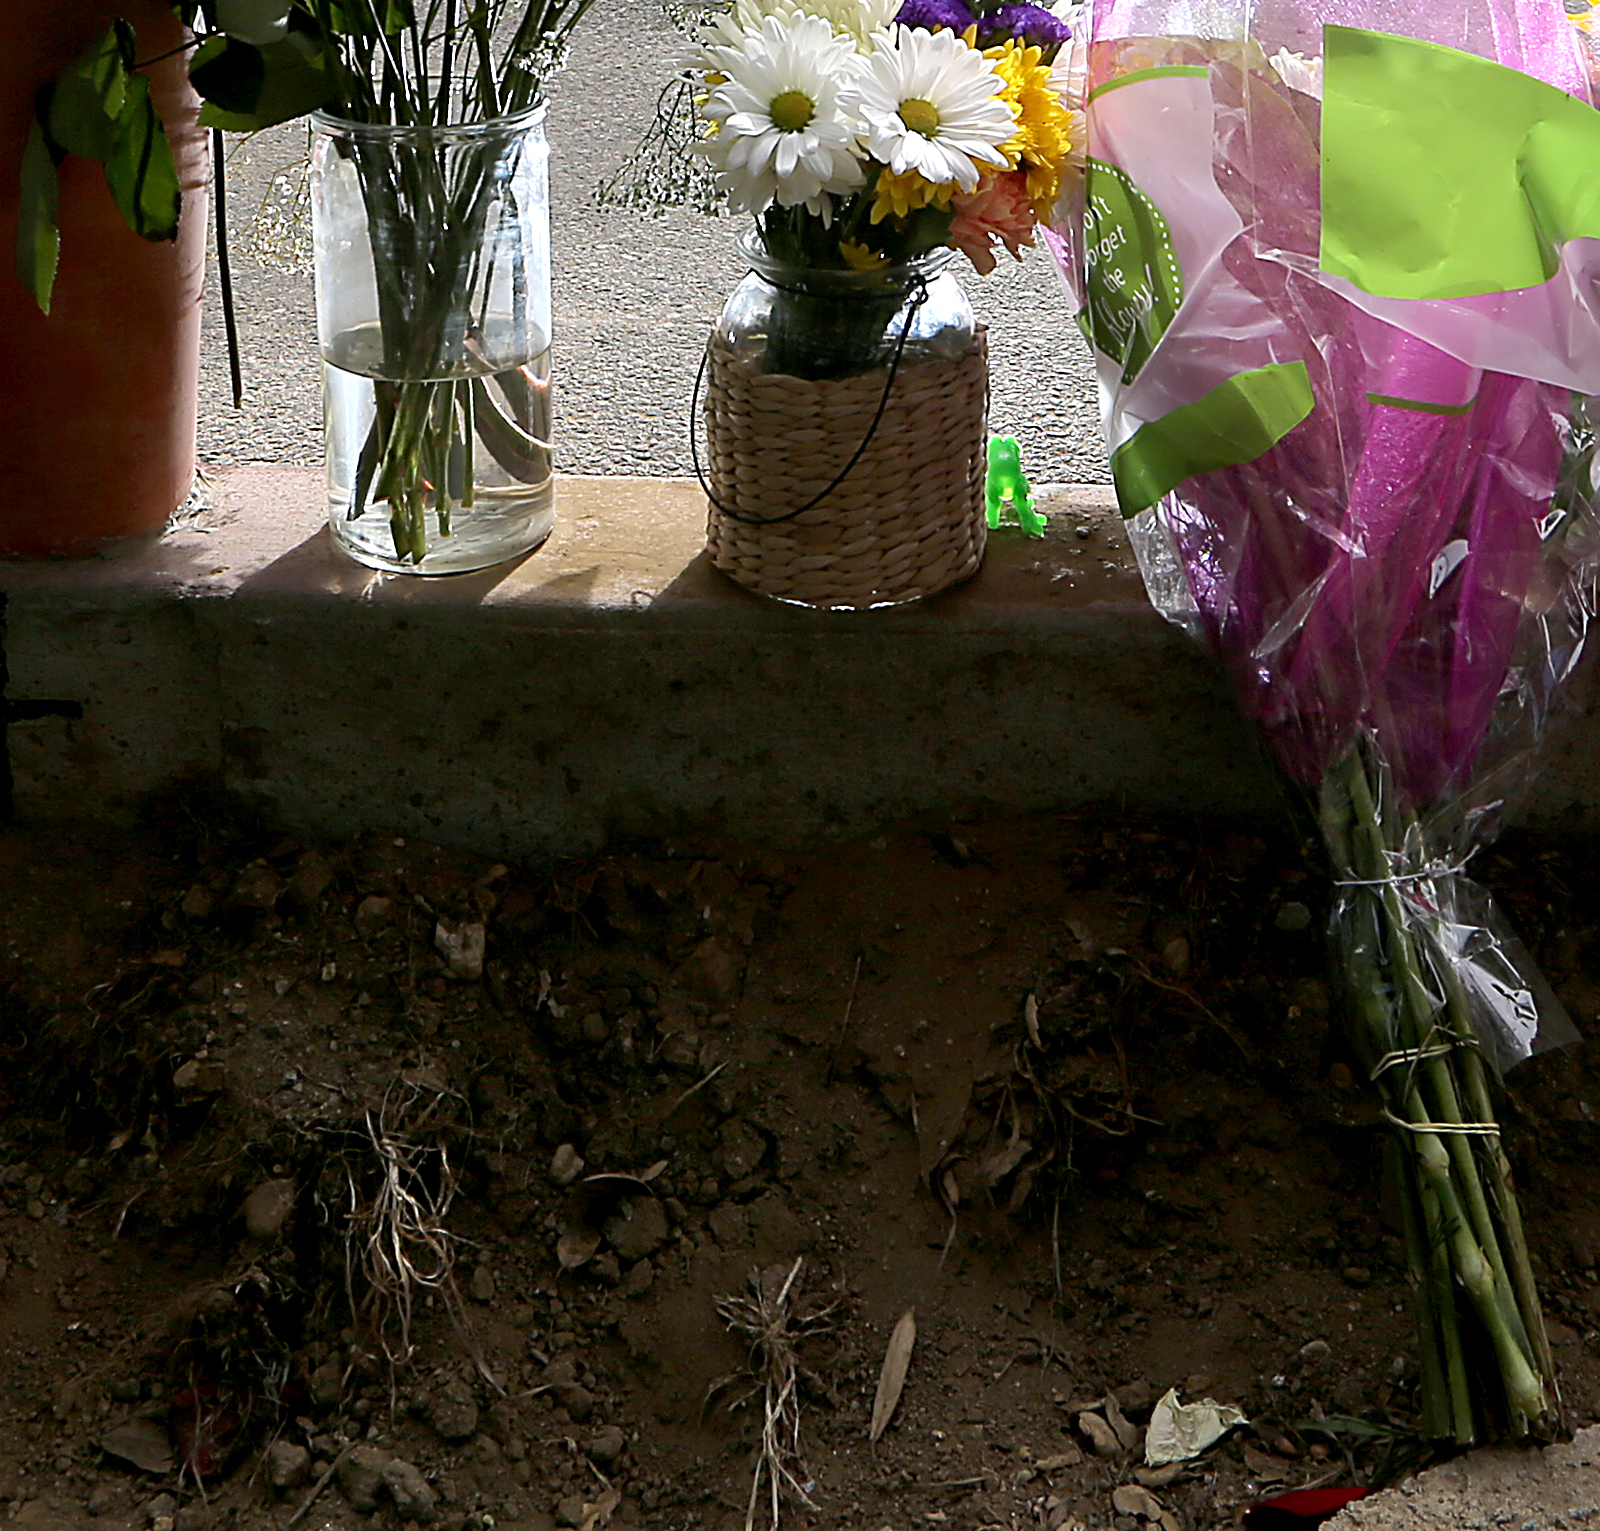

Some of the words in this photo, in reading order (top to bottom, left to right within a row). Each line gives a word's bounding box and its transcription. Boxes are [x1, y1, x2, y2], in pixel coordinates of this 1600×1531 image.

[1084, 195, 1112, 230] on't
[1089, 224, 1127, 266] orget
[1102, 267, 1126, 293] the
